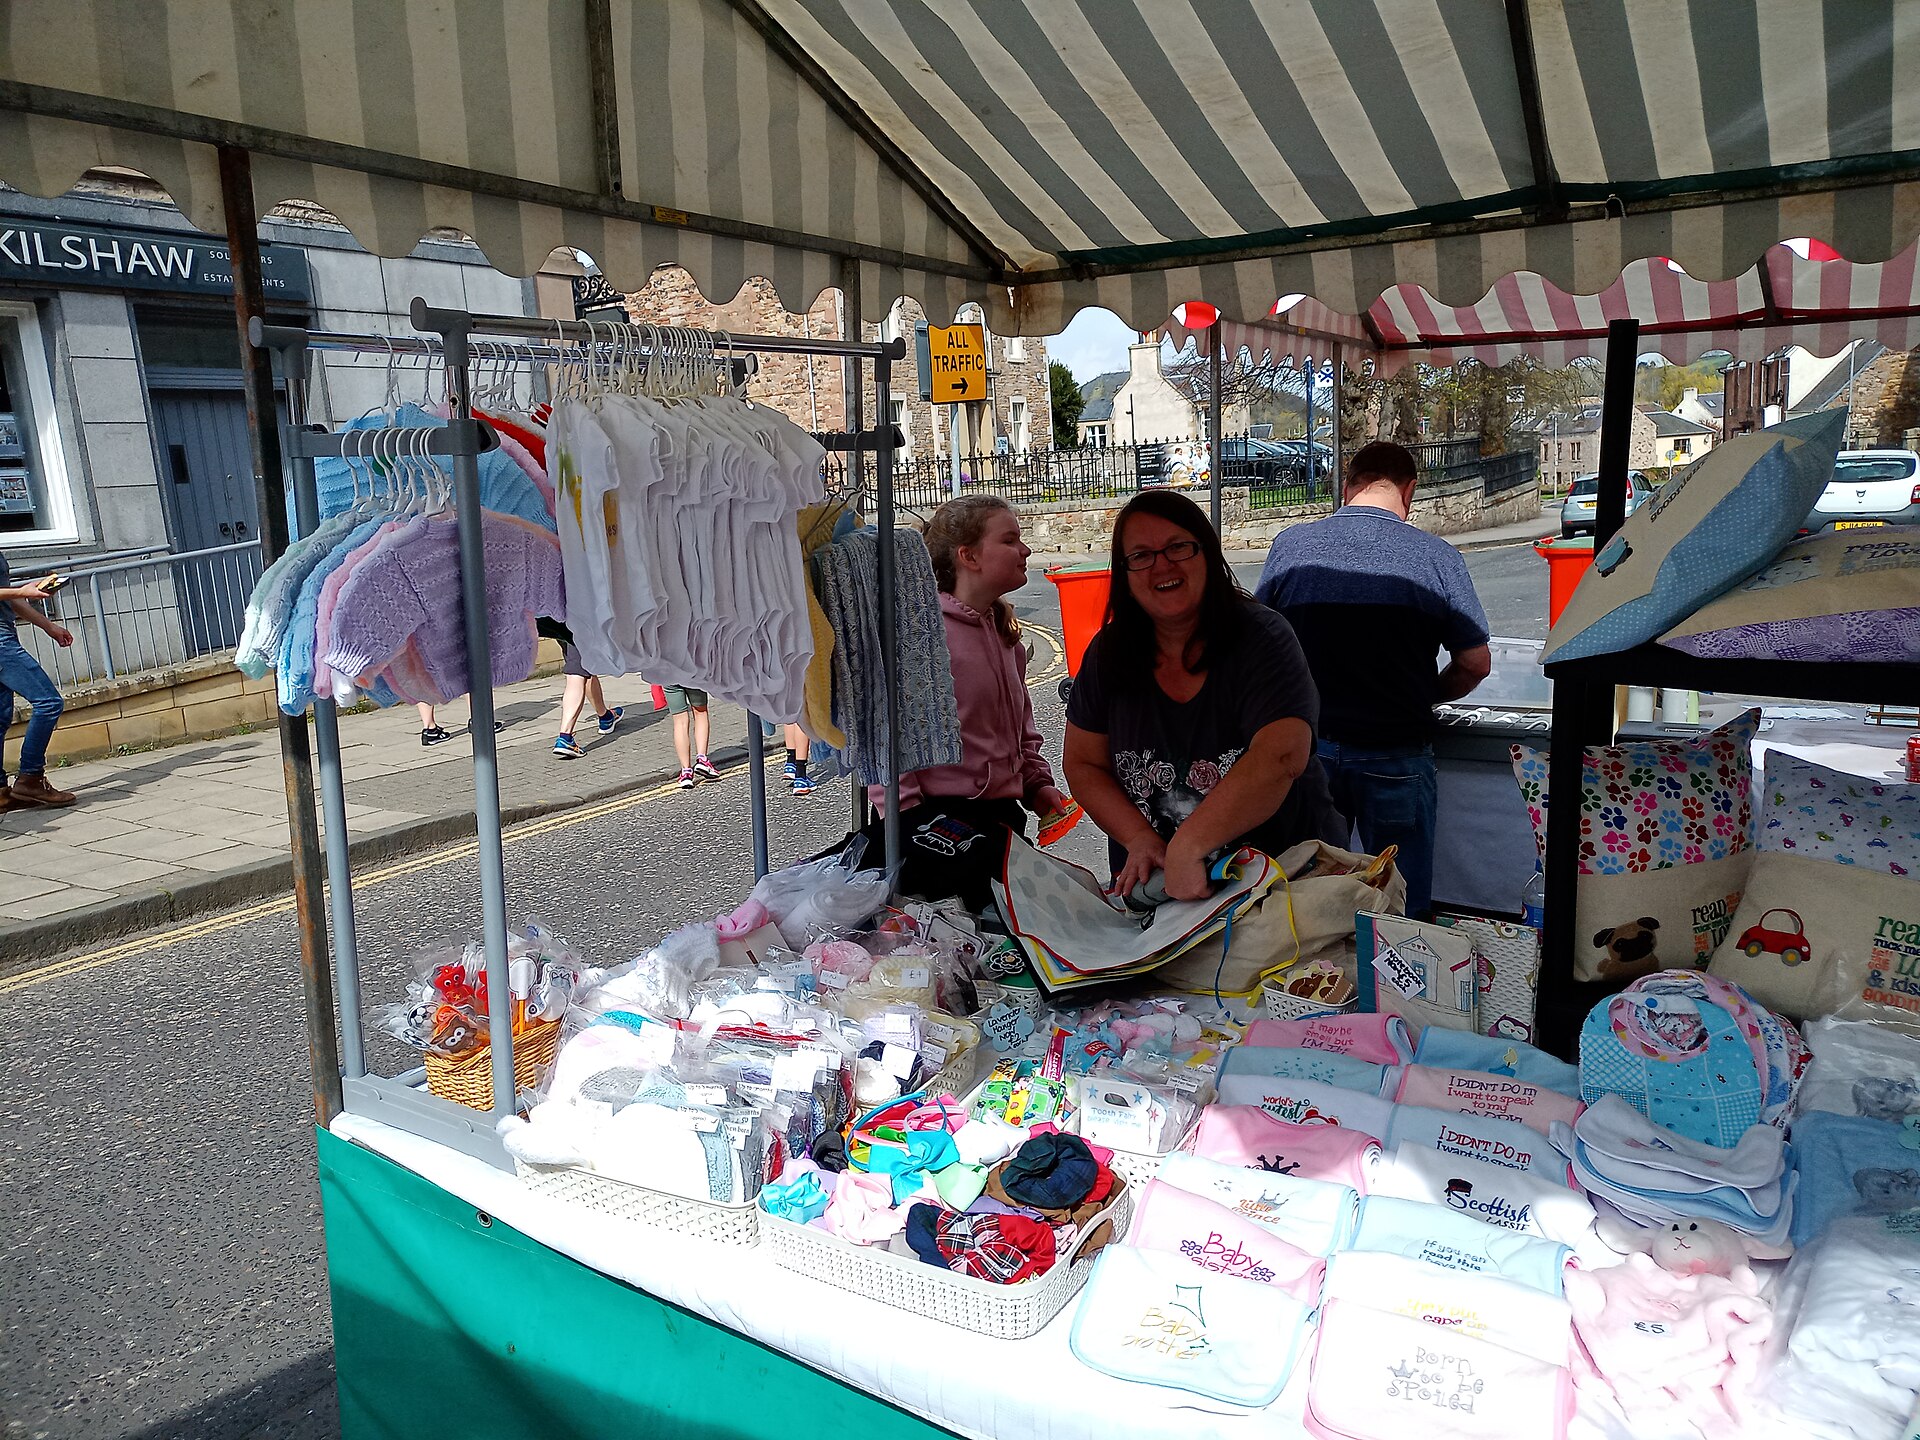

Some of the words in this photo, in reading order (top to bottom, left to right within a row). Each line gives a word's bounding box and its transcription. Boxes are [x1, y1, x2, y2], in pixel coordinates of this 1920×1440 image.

[0, 229, 194, 279] KILSHAW
[947, 331, 969, 349] ALL
[933, 354, 984, 373] TRAFFIC
[1875, 916, 1920, 946] rea
[1448, 1075, 1456, 1087] I
[1500, 1082, 1521, 1095] DO
[1453, 1089, 1484, 1101] want
[1485, 1093, 1498, 1102] to
[1500, 1095, 1535, 1106] speak
[1472, 1100, 1486, 1109] to
[1487, 1102, 1508, 1114] my
[1438, 1125, 1447, 1140] I
[1446, 1130, 1492, 1152] DIDN'T
[1493, 1141, 1515, 1159] DO
[1441, 1144, 1475, 1158] want
[1446, 1191, 1531, 1223] Scottish
[1202, 1231, 1263, 1272] Baby
[1437, 1244, 1461, 1256] you
[1140, 1307, 1207, 1343] Baby
[1422, 1314, 1463, 1325] cape
[1416, 1345, 1476, 1377] Born
